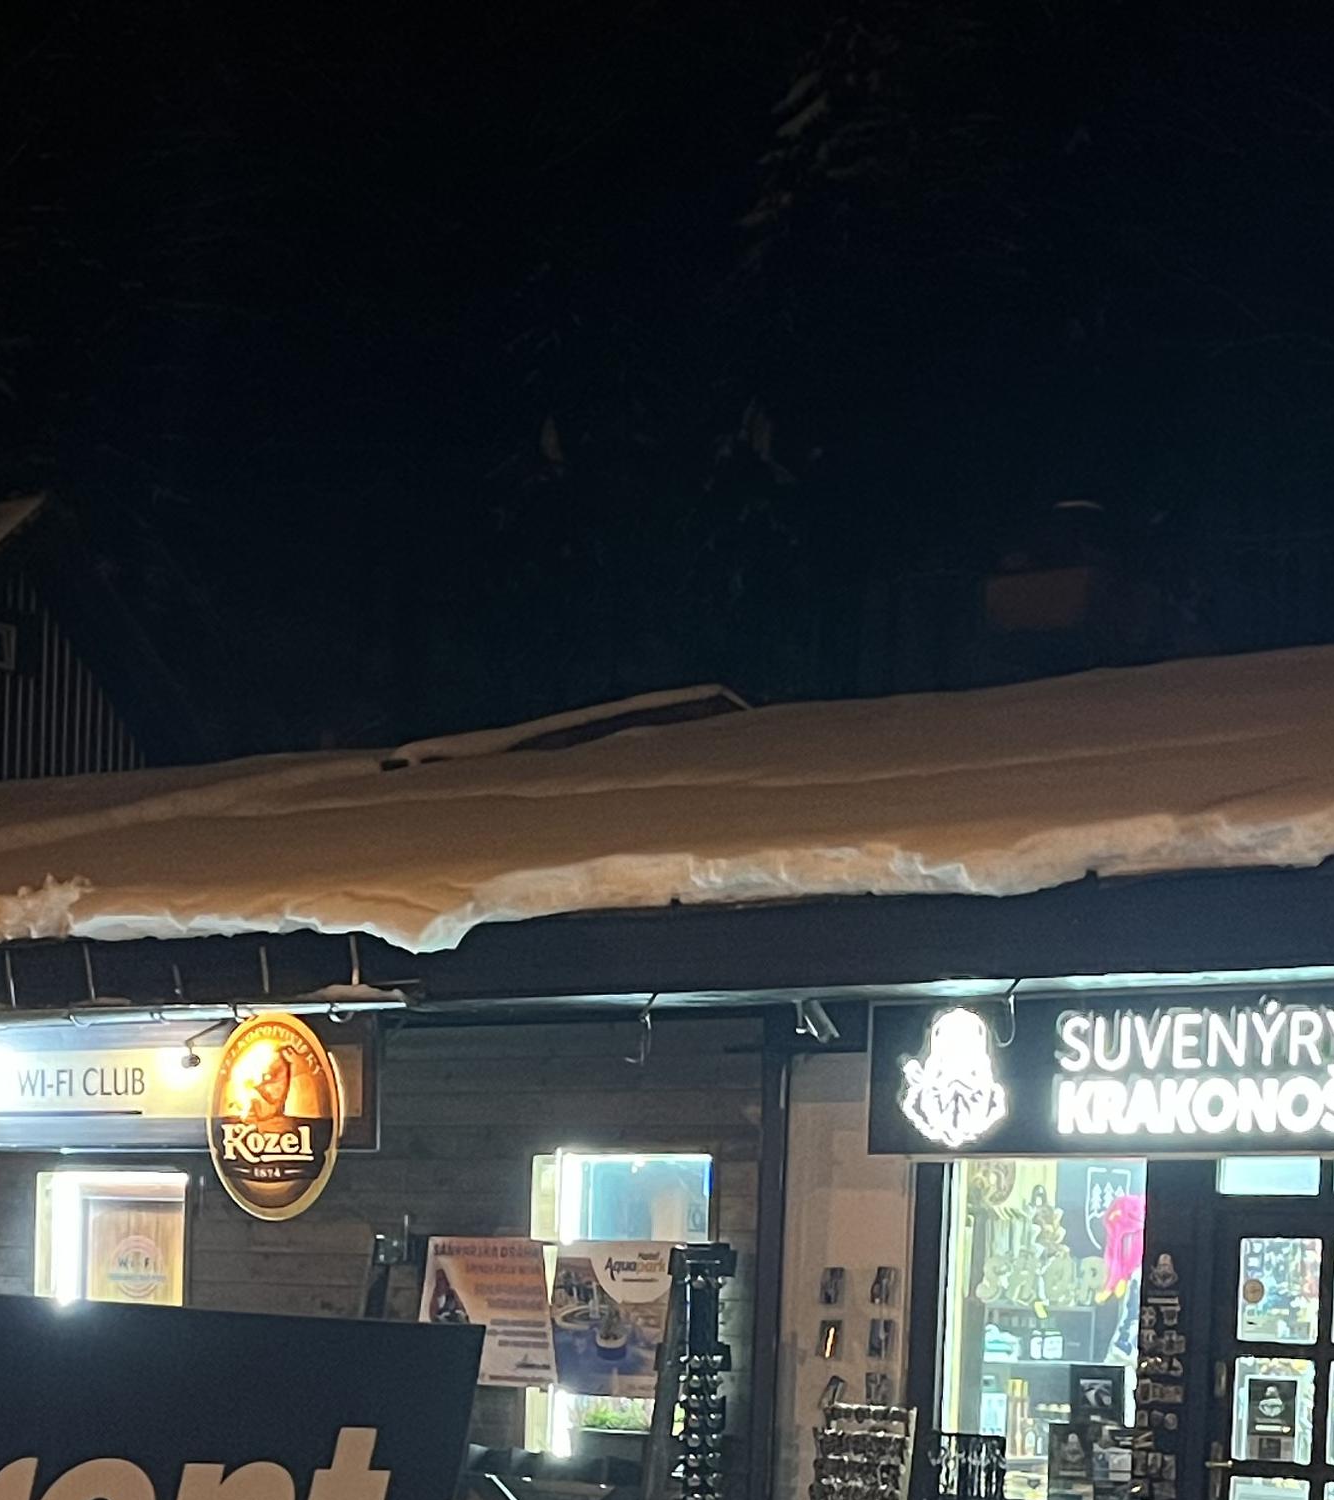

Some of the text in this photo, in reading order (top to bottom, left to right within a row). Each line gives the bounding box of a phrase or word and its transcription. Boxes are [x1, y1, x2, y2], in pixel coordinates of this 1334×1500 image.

[17, 1067, 145, 1097] WI-FI CLUB
[221, 1123, 314, 1163] Kozel
[604, 1256, 666, 1282] Aquapark
